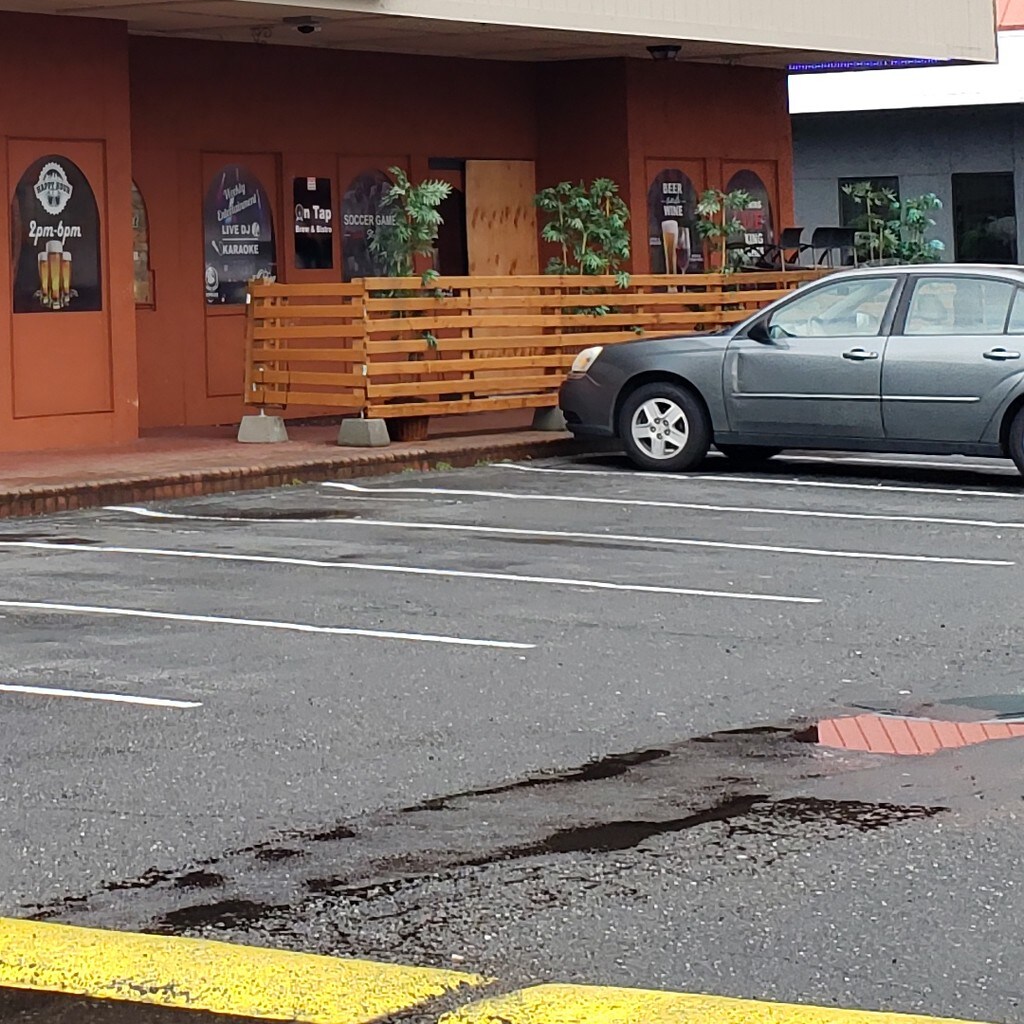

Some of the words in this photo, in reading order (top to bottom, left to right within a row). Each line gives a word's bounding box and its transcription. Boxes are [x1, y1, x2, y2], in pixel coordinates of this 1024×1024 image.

[36, 181, 55, 194] HAPPY
[56, 181, 71, 195] HOUR
[662, 182, 683, 195] BEER
[295, 203, 311, 222] On
[312, 205, 332, 223] Tap
[663, 205, 684, 217] WINE
[343, 215, 374, 226] SOCCER
[29, 220, 82, 246] 2pm-6pm
[222, 224, 239, 235] LIVE
[240, 224, 251, 235] DJ
[295, 224, 310, 234] Brew
[310, 225, 315, 234] &
[316, 225, 333, 234] Bistro
[222, 244, 259, 255] KARAOKE
